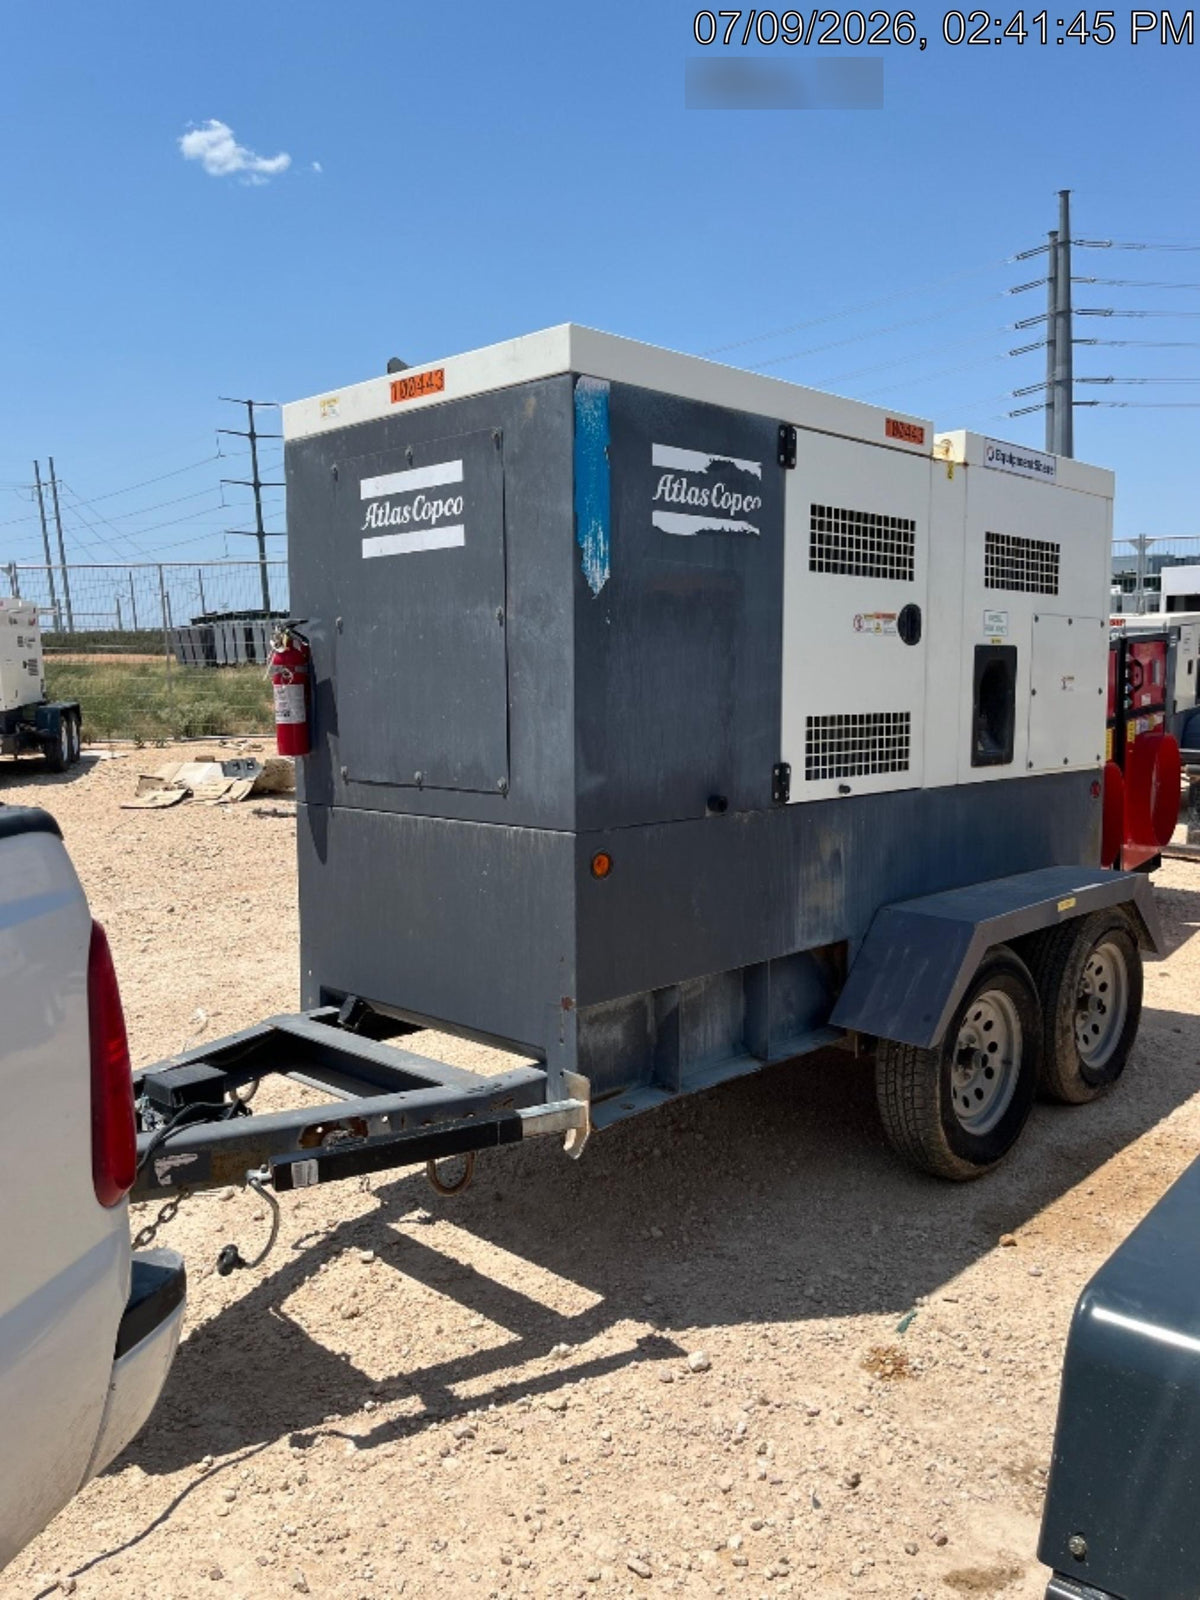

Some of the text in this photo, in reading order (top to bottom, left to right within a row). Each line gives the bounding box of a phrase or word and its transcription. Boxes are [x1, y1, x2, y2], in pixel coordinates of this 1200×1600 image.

[361, 495, 463, 530] Atlas Copco
[652, 474, 761, 516] Atlas Copco
